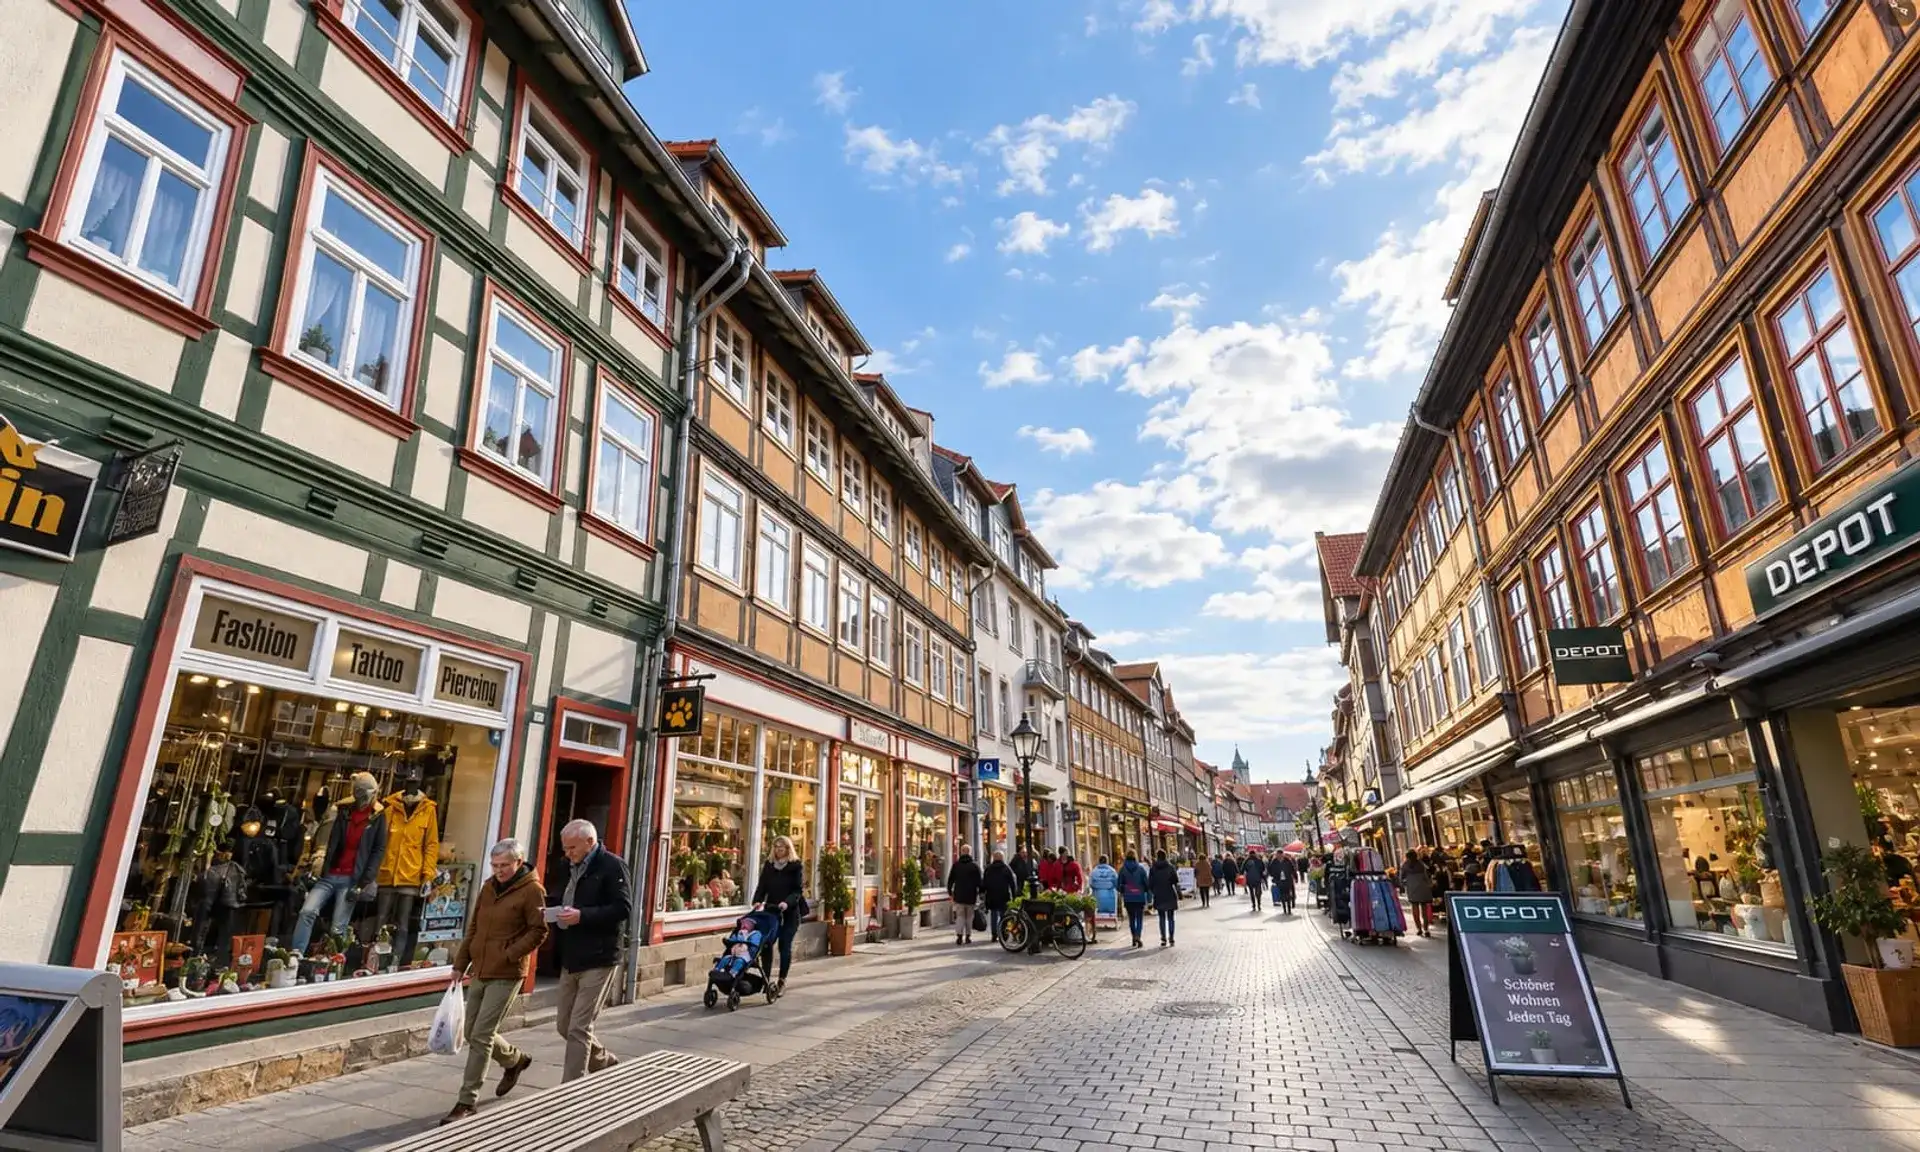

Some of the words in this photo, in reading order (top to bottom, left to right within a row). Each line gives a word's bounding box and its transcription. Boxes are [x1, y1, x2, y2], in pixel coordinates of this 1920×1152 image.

[1765, 492, 1896, 597] DEPOT
[211, 609, 298, 661] Fashion
[1555, 645, 1623, 657] DEPOT
[350, 643, 404, 683] Tattoo
[440, 666, 497, 706] Piercing
[1463, 906, 1553, 919] DEPOT
[1503, 978, 1555, 991] Schöner
[1507, 993, 1561, 1007] Wohnen
[1505, 1010, 1545, 1024] Jeden
[1546, 1011, 1572, 1027] Tag
